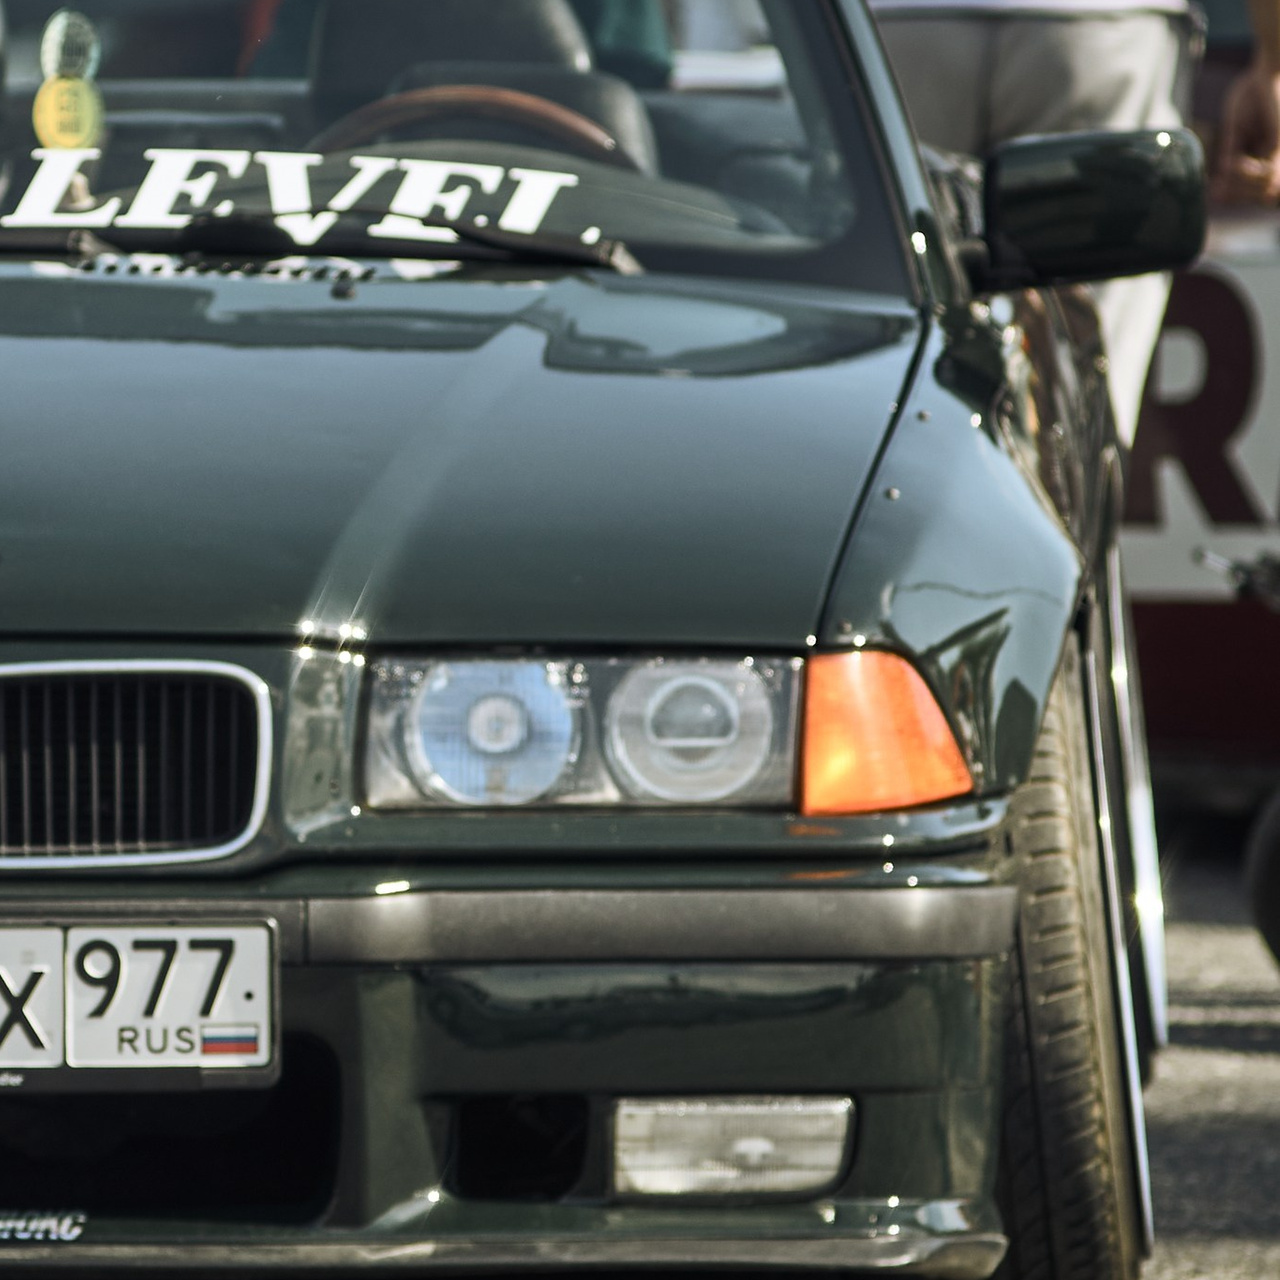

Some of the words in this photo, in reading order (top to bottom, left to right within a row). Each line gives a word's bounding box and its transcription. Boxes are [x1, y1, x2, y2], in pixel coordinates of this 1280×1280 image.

[0, 148, 601, 246] LEVEL
[74, 939, 236, 1019] 977
[118, 1026, 196, 1055] RUS
